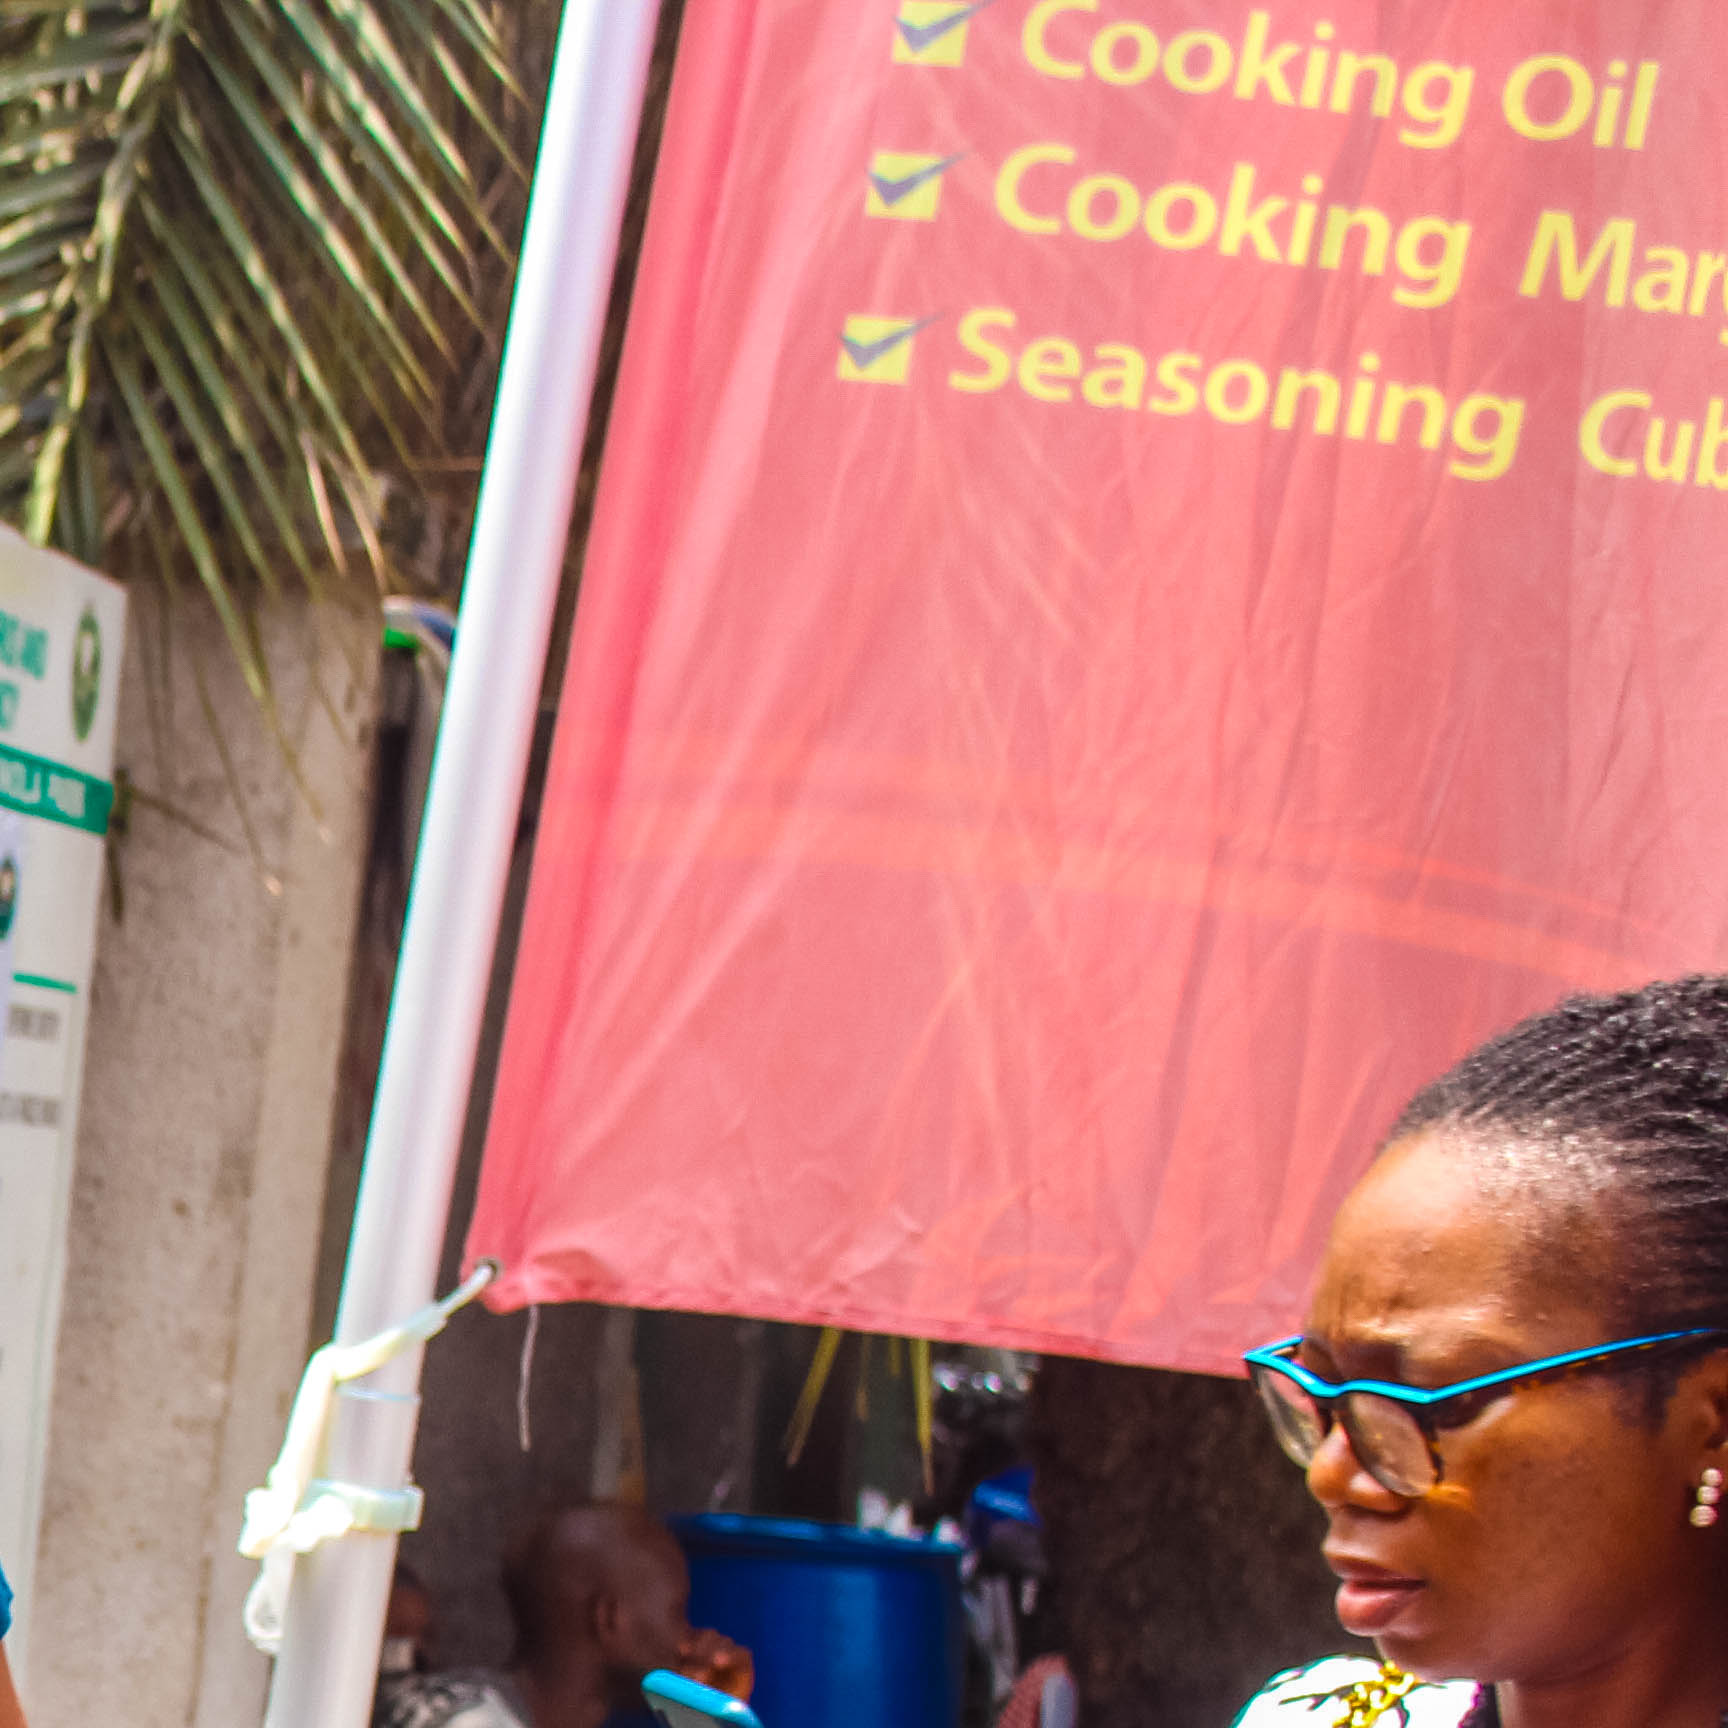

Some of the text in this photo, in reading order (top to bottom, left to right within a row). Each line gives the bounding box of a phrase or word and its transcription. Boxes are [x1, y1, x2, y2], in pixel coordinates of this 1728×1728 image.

[1021, 0, 1660, 151] Cooking Oil
[994, 143, 1728, 346] Cooking Mar
[948, 305, 1526, 483] Seasoning
